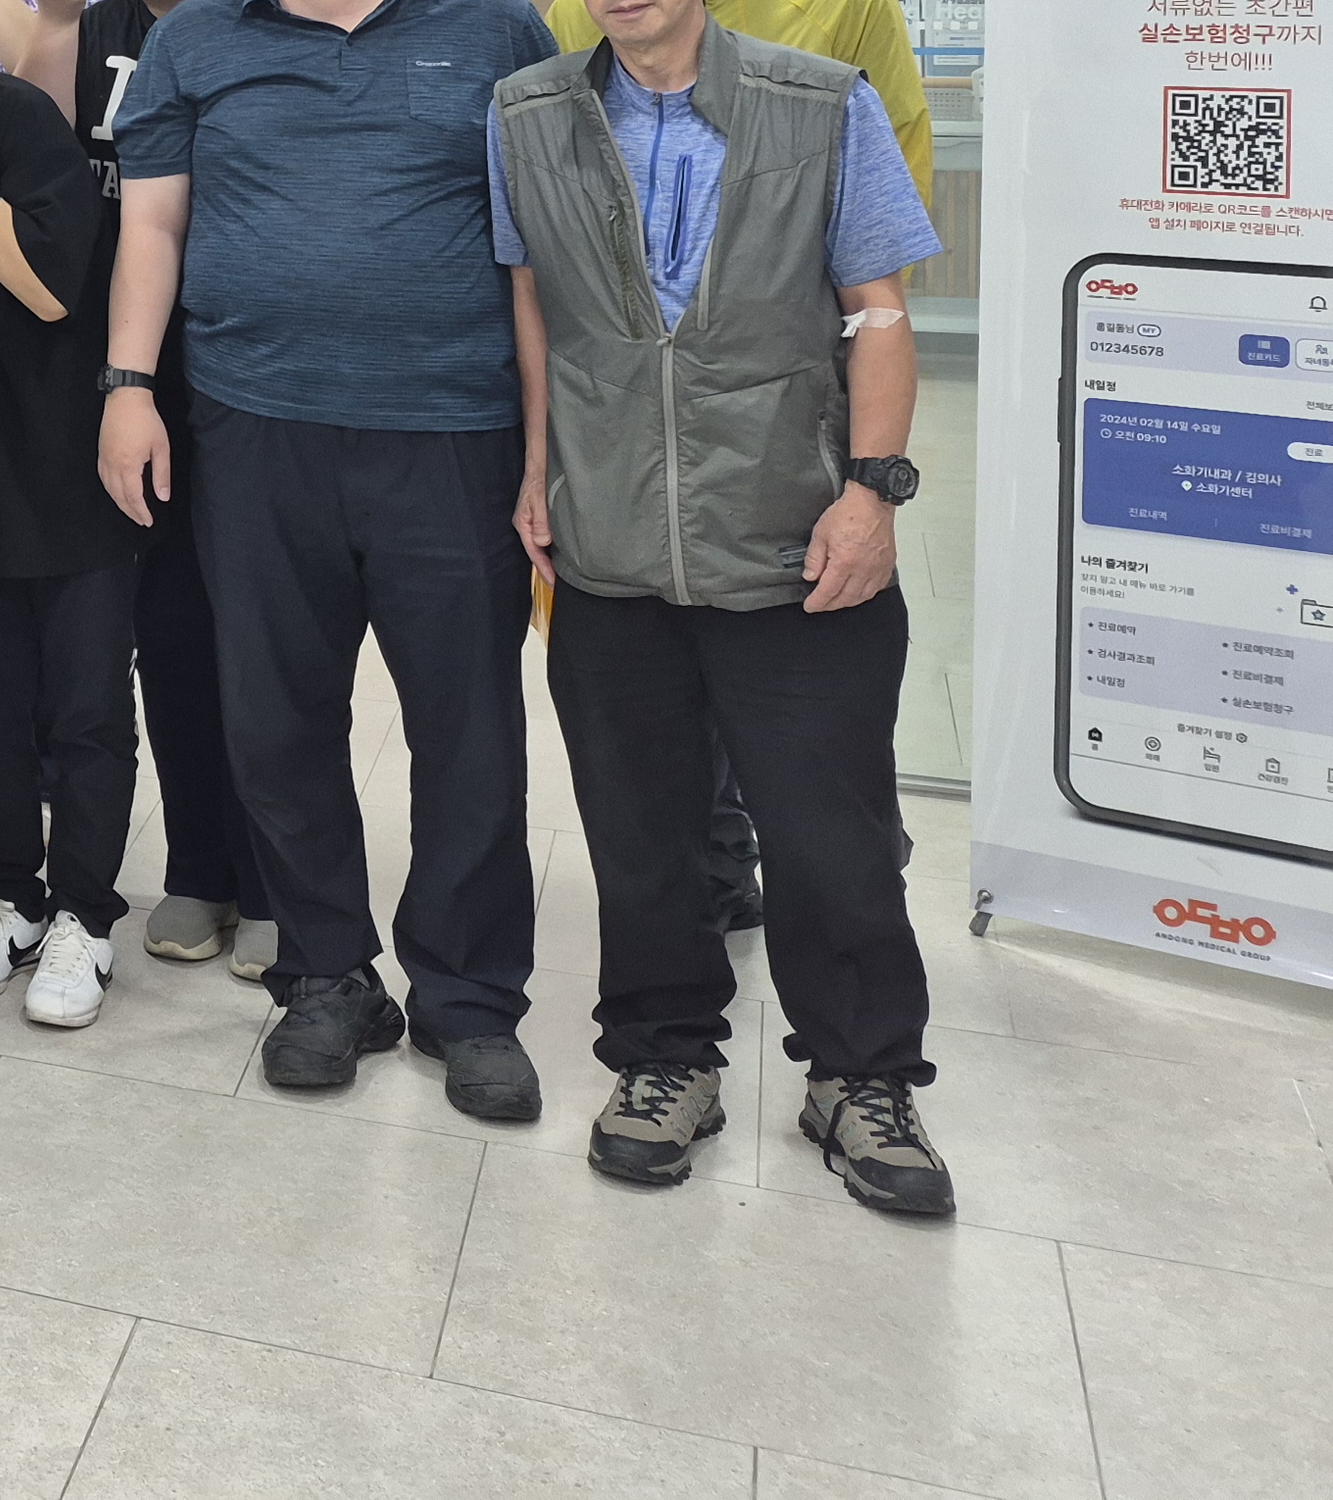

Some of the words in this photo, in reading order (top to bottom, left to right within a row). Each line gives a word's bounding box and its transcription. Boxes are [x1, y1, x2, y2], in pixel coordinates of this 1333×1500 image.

[1138, 22, 1323, 46] 실손보험청구까지
[1184, 50, 1274, 72] 한번에!!!
[1118, 197, 1165, 213] 휴대전화
[1167, 200, 1215, 215] 카메라로
[1217, 203, 1273, 219] QR코드를
[1148, 217, 1161, 230] 앱
[1163, 218, 1187, 232] 설치
[1189, 219, 1237, 233] 페이지로
[1239, 221, 1305, 237] 연결됩니다.
[1089, 341, 1164, 357] 012345678
[1084, 379, 1117, 392] 내일정
[1100, 413, 1138, 426] 2024년
[1139, 418, 1164, 429] 02월
[1166, 420, 1189, 431] 14일
[1191, 422, 1221, 435] 수요일
[1114, 430, 1135, 441] 오전
[1136, 432, 1167, 444] 09:10
[1171, 463, 1233, 481] 소화기내과
[1245, 471, 1283, 487] 김의사
[1195, 482, 1253, 499] 소화기센터
[1080, 555, 1103, 568] 나의
[1105, 558, 1149, 574] 즐겨찾기
[1097, 648, 1156, 667] 검사결과조회
[1096, 675, 1126, 688] 내일정
[1154, 931, 1195, 946] ANDONG
[1197, 941, 1238, 956] MEDICAL
[1240, 950, 1272, 962] GROUP
